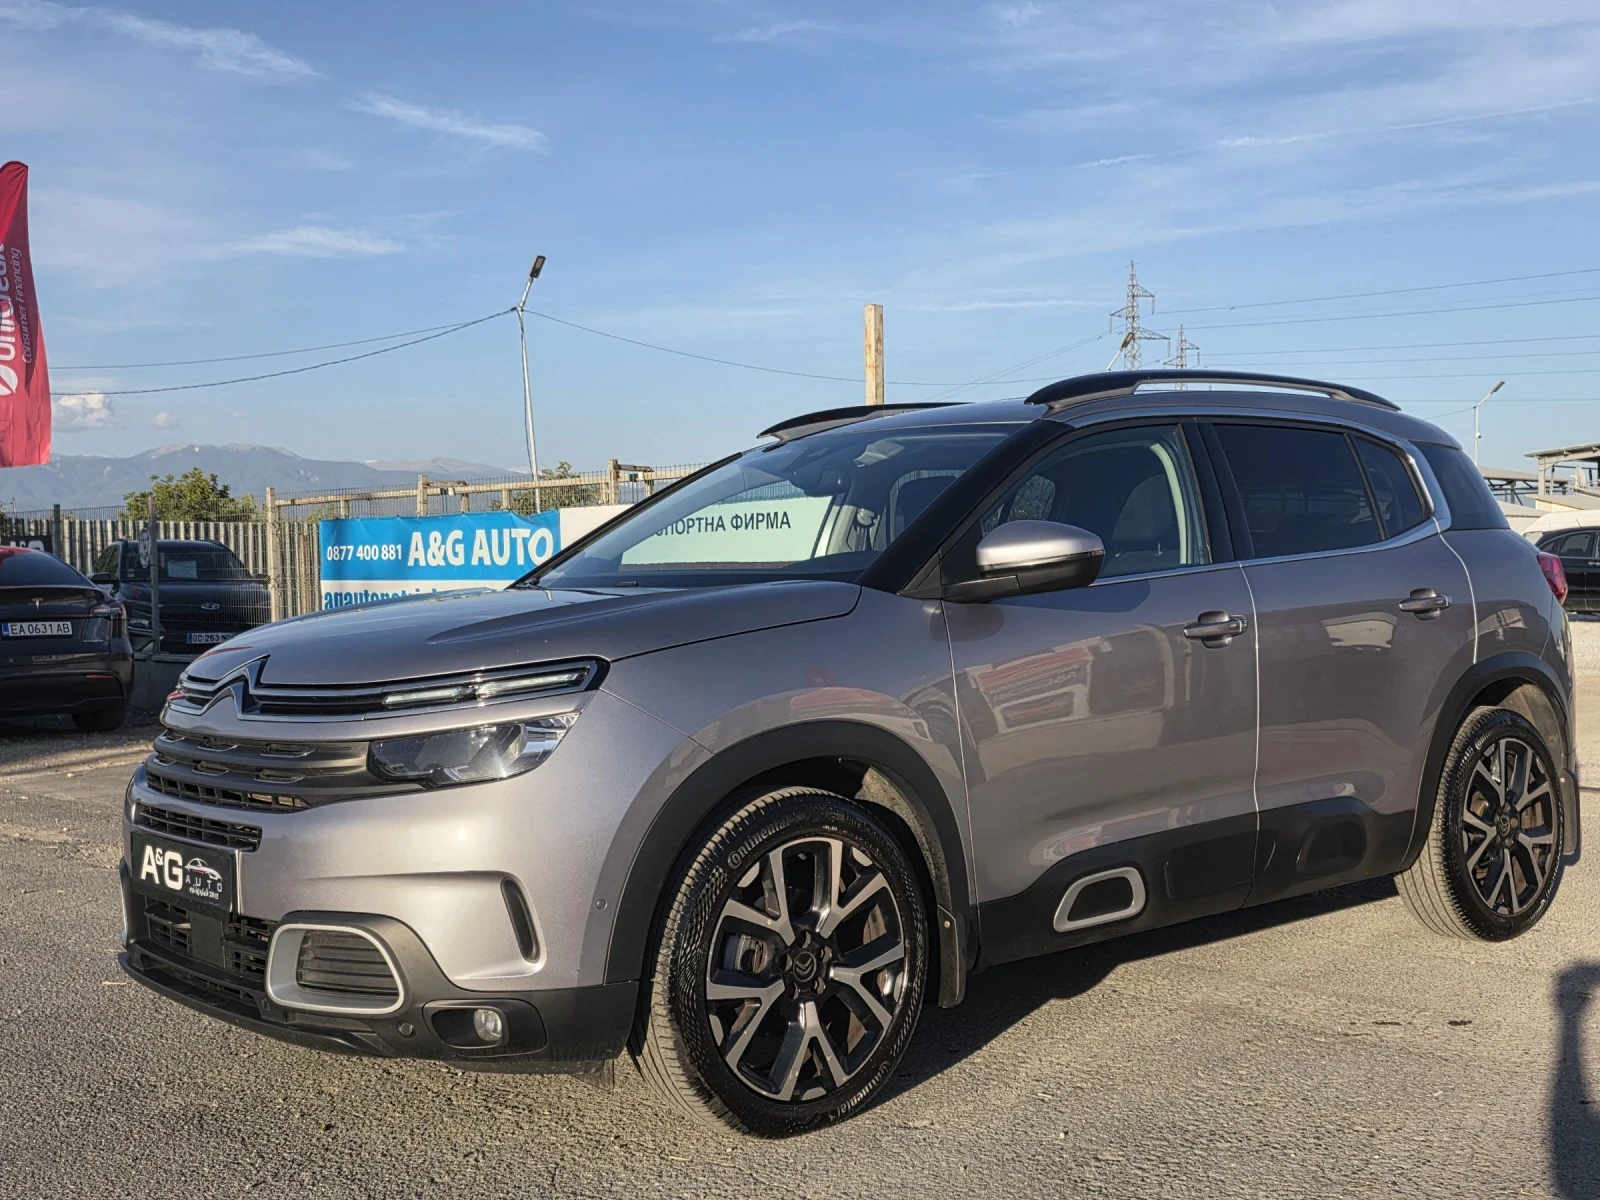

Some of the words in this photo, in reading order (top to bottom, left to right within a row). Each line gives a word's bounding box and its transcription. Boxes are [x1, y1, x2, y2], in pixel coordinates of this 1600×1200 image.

[10, 247, 25, 303] Financing
[19, 304, 32, 363] Consumer
[730, 511, 791, 531] ФИРМА
[326, 545, 354, 561] 0877
[356, 544, 379, 561] 400
[381, 544, 402, 560] 881
[407, 530, 465, 567] A&G
[471, 527, 554, 566] AUTO
[10, 624, 26, 635] EA
[28, 623, 54, 634] 0631
[57, 623, 70, 634] AB
[727, 814, 790, 869] Continental
[140, 845, 183, 890] A&G
[185, 874, 223, 893] AUTO
